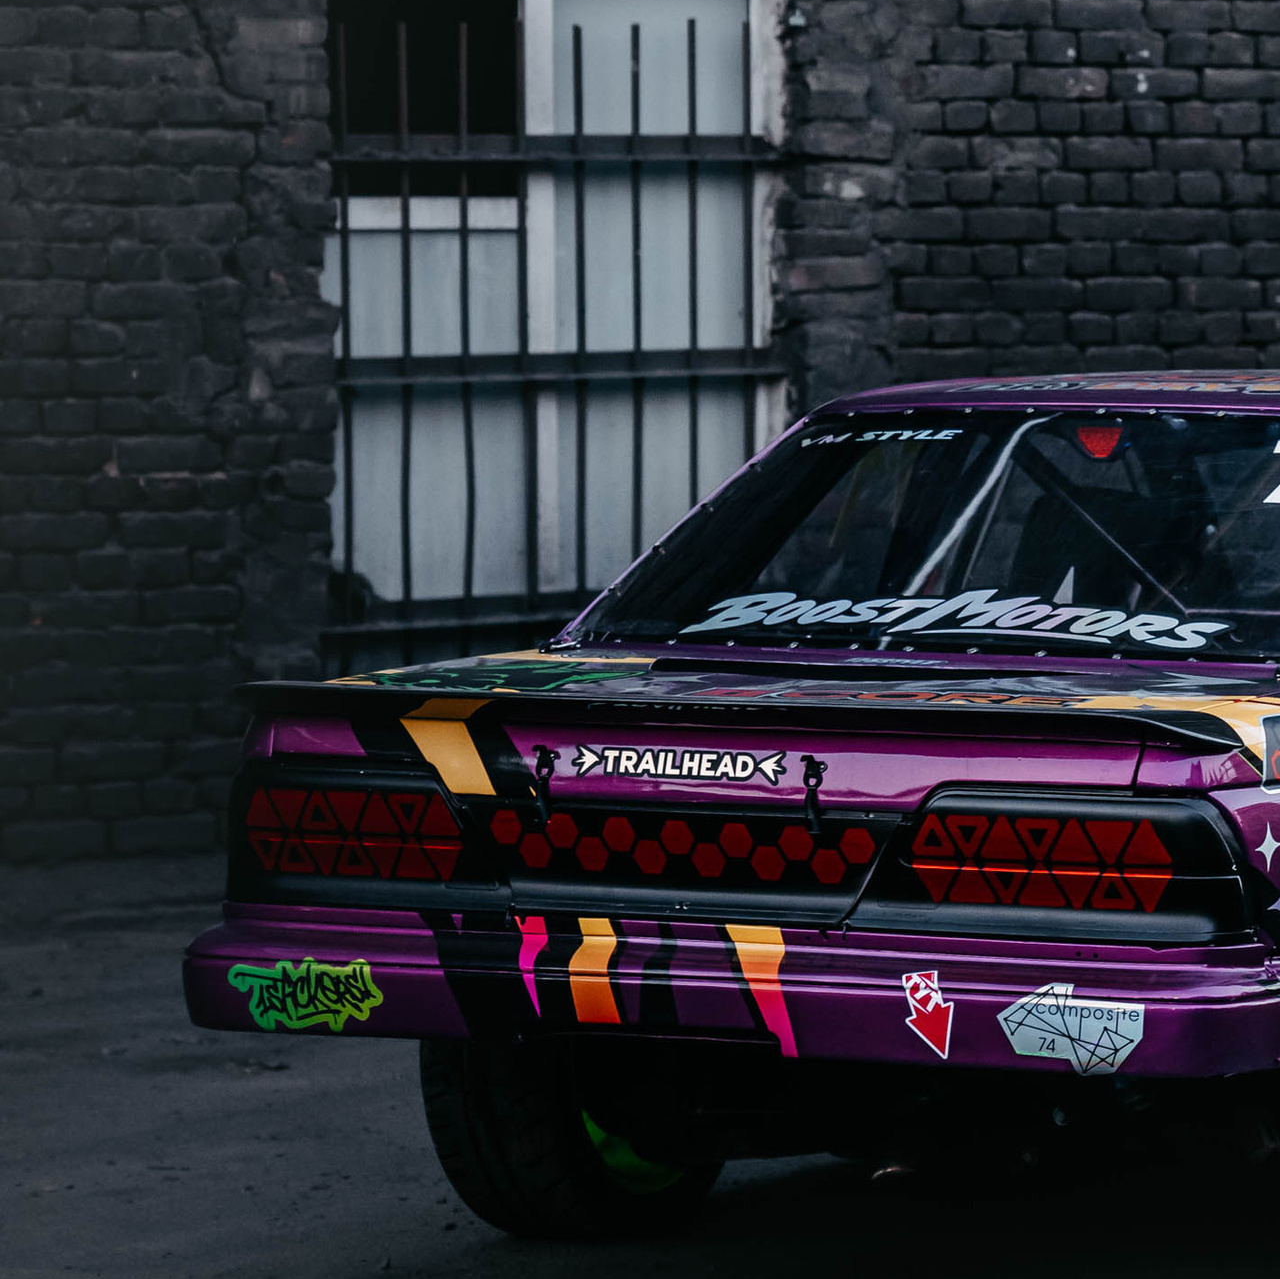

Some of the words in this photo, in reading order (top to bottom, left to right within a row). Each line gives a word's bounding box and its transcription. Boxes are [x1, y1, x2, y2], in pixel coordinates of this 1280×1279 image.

[855, 429, 964, 442] STYLE
[602, 748, 756, 779] TRAILHEAD
[1036, 1002, 1141, 1026] composite
[1038, 1036, 1056, 1054] 74
